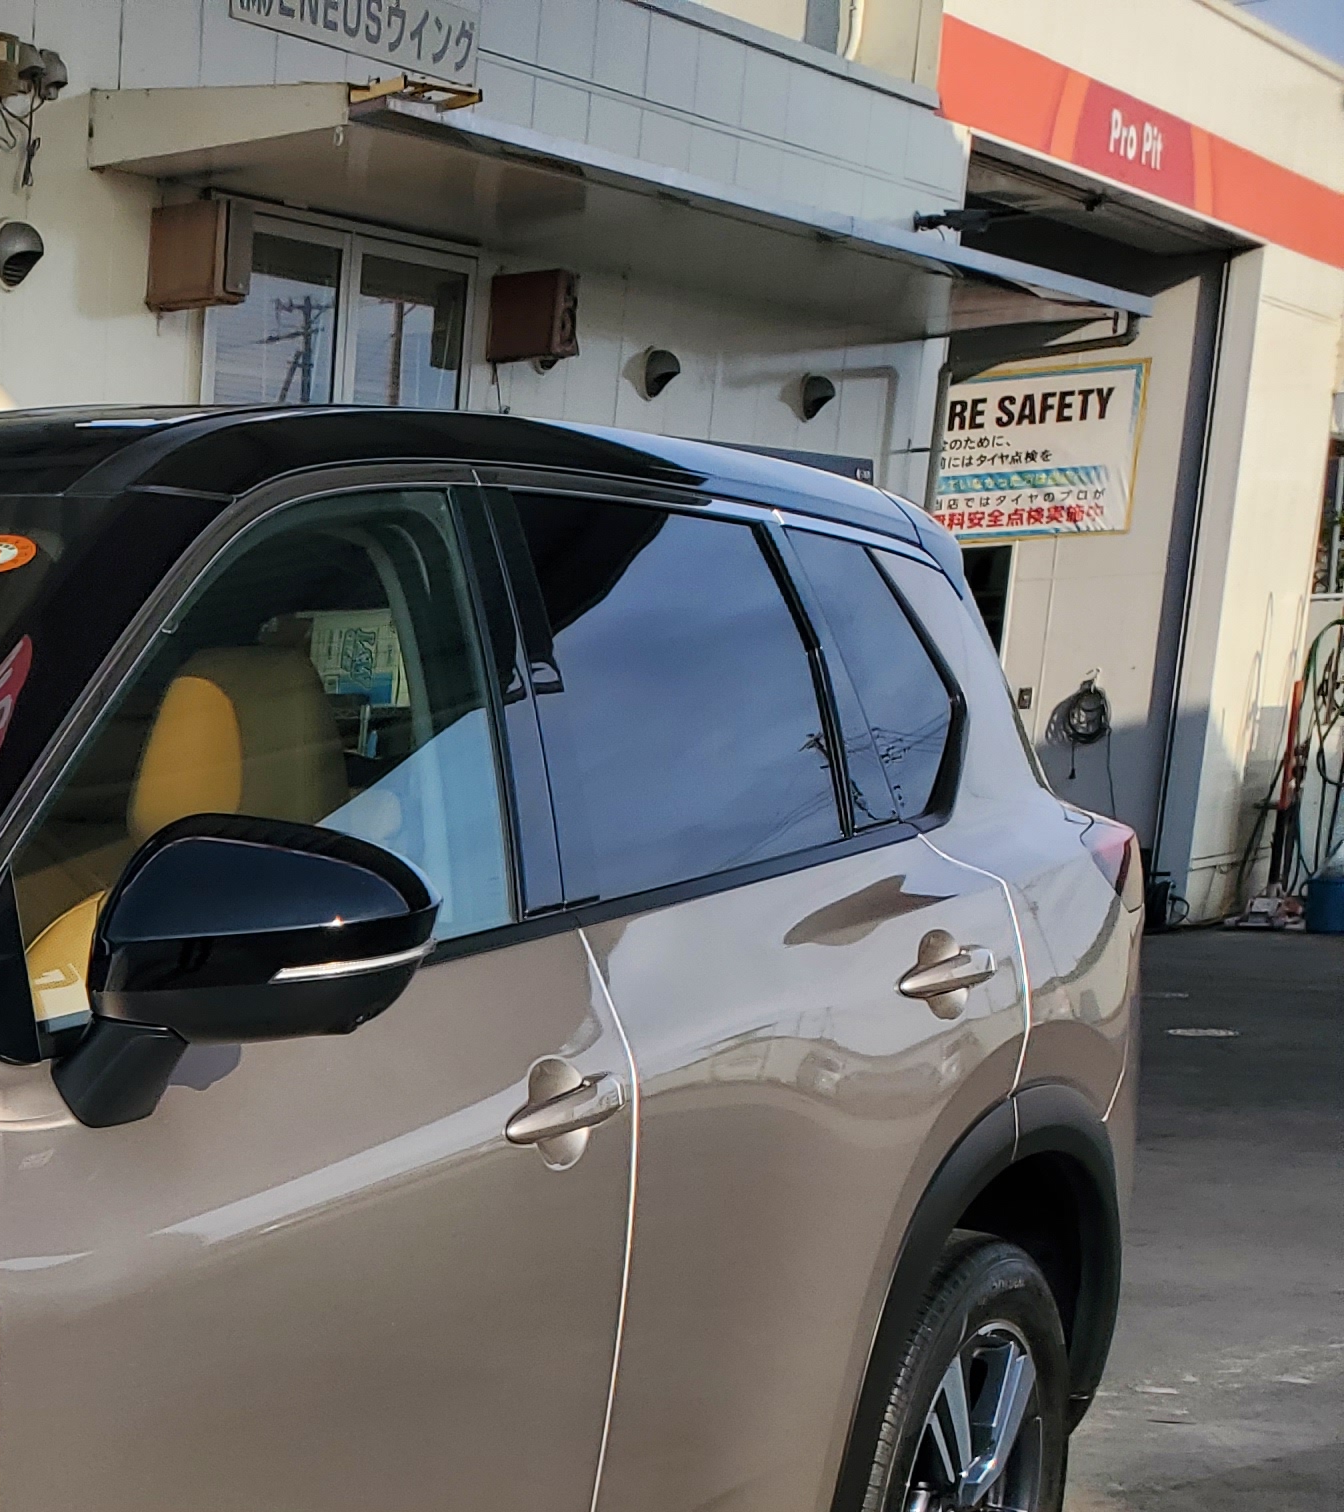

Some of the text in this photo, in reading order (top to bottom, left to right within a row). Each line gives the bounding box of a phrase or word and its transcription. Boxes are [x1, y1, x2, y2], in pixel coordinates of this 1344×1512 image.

[1109, 108, 1164, 171] Pro Pit
[995, 386, 1116, 428] SAFETY
